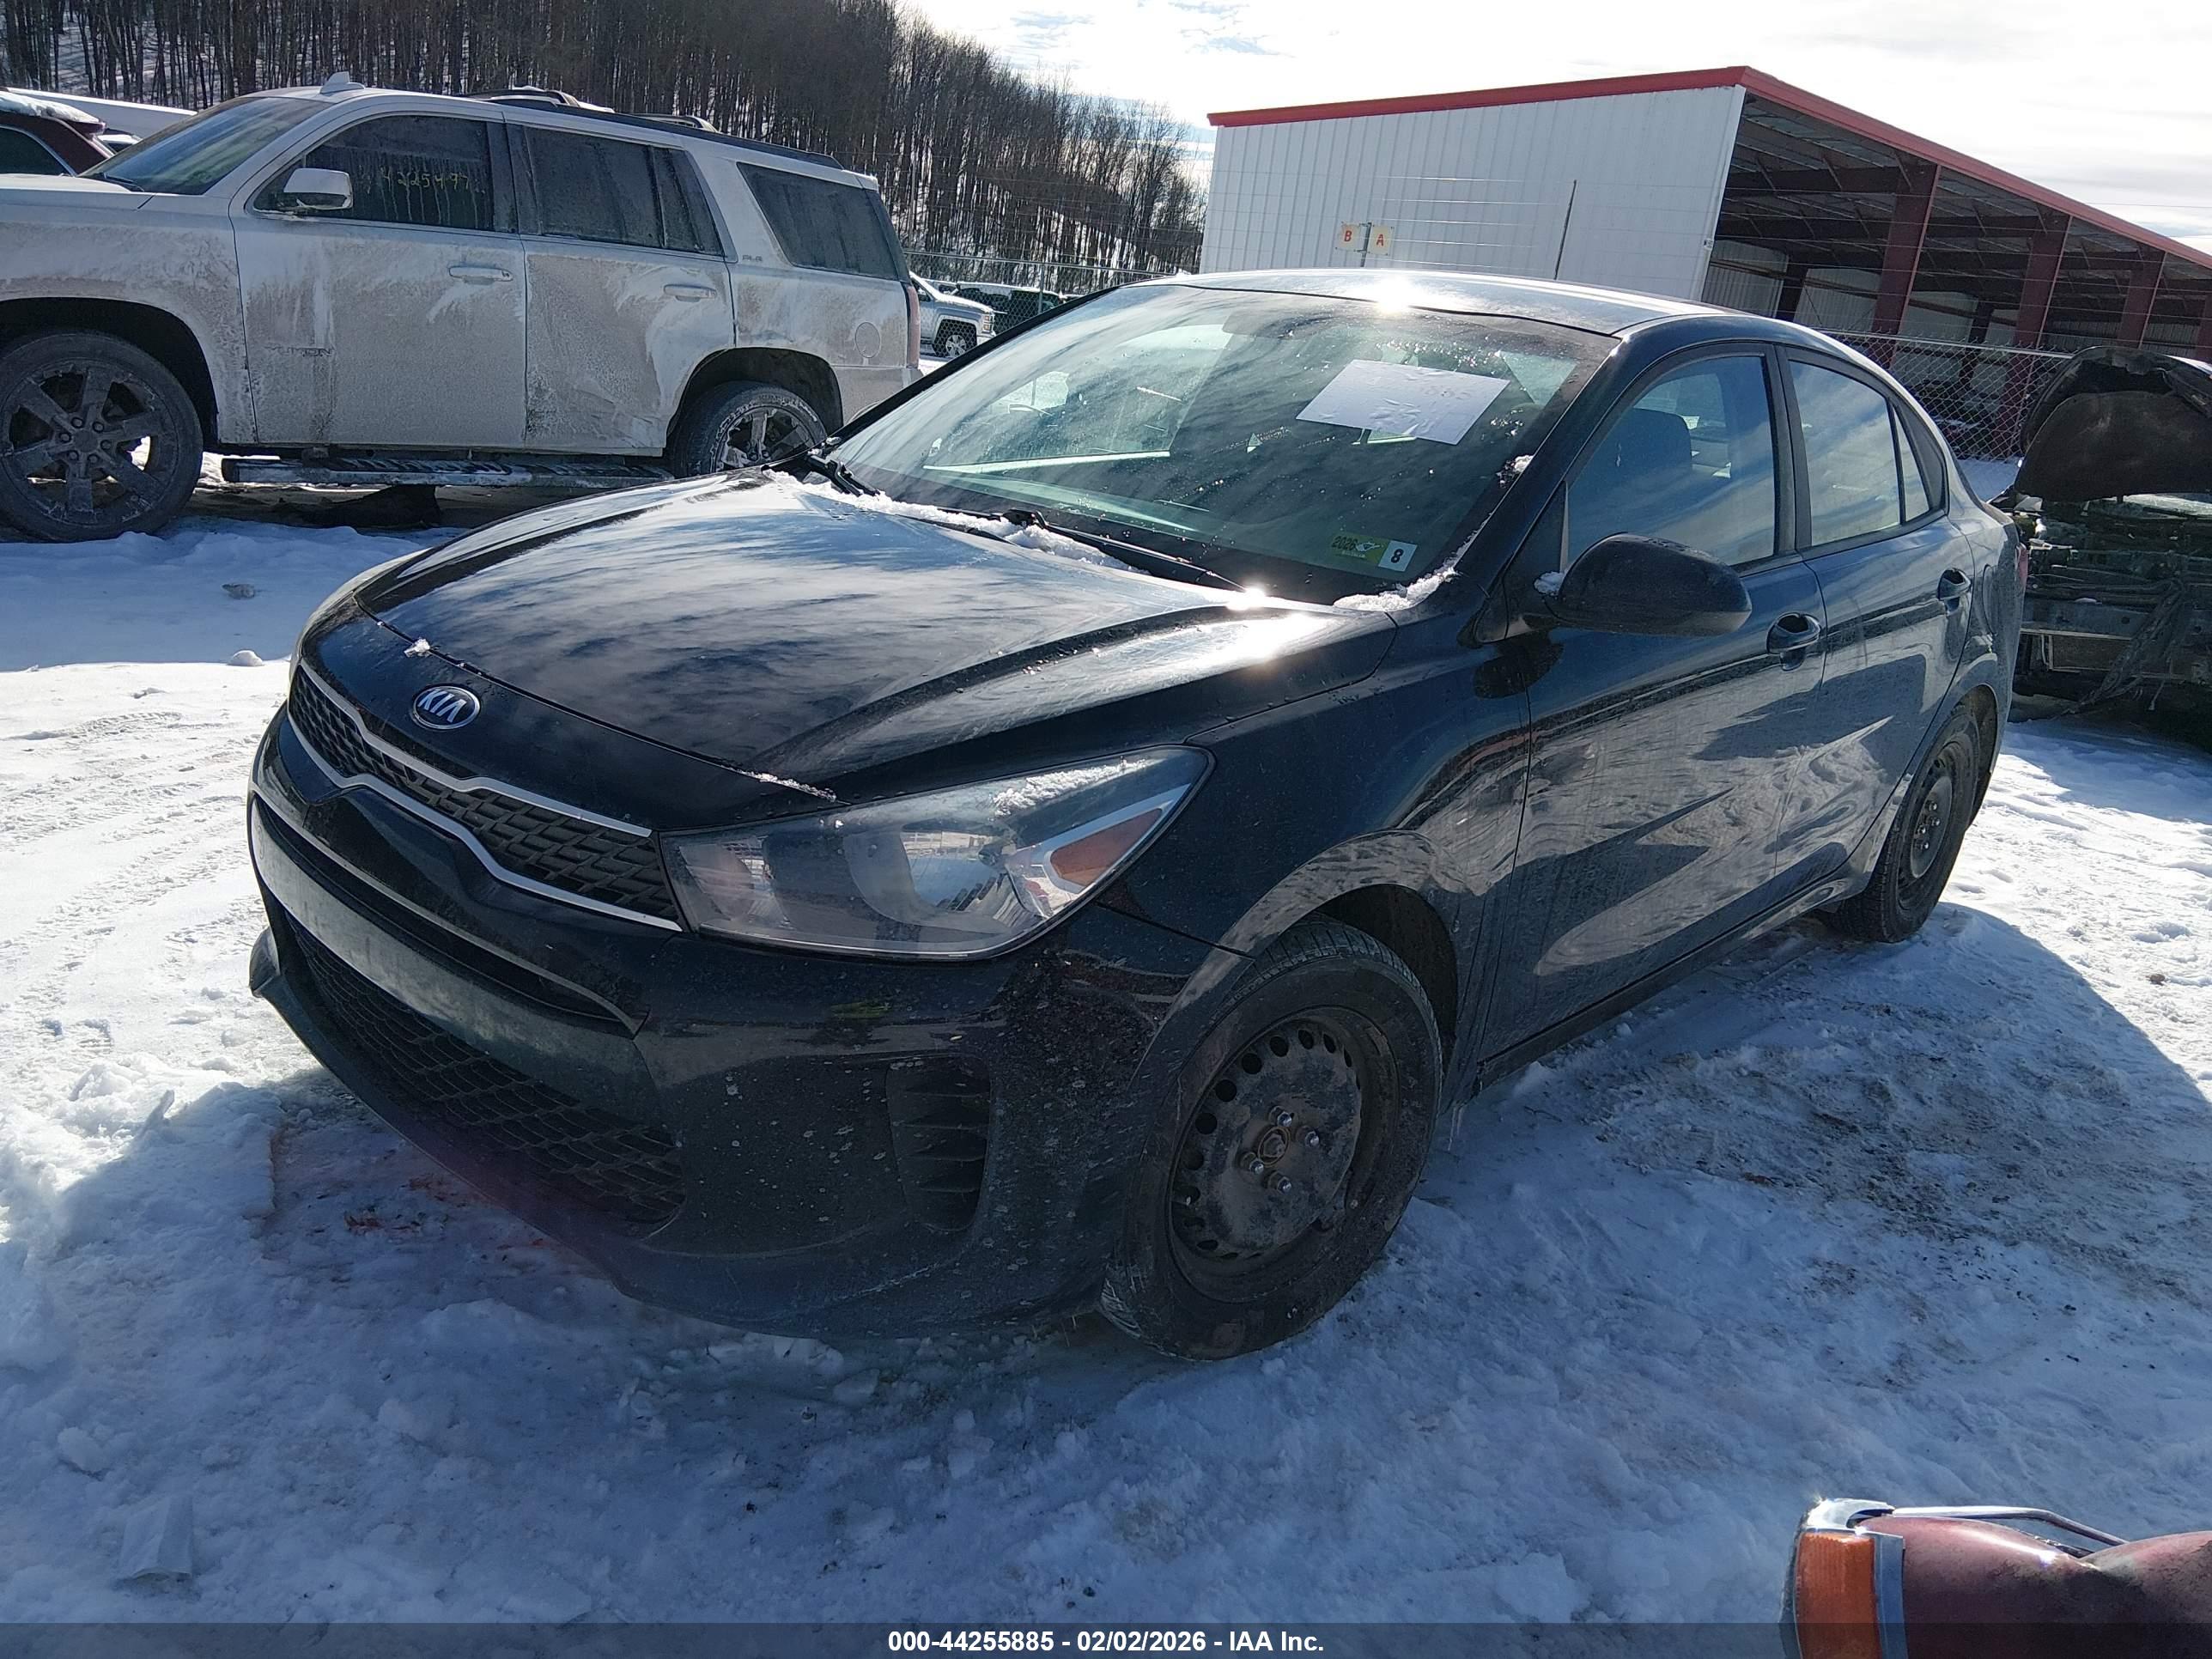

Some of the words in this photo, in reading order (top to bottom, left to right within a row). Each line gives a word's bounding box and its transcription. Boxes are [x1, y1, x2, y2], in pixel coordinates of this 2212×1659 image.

[1344, 230, 1352, 241] B
[1376, 234, 1384, 246] A
[1391, 548, 1404, 563] 8
[417, 689, 467, 723] KIA
